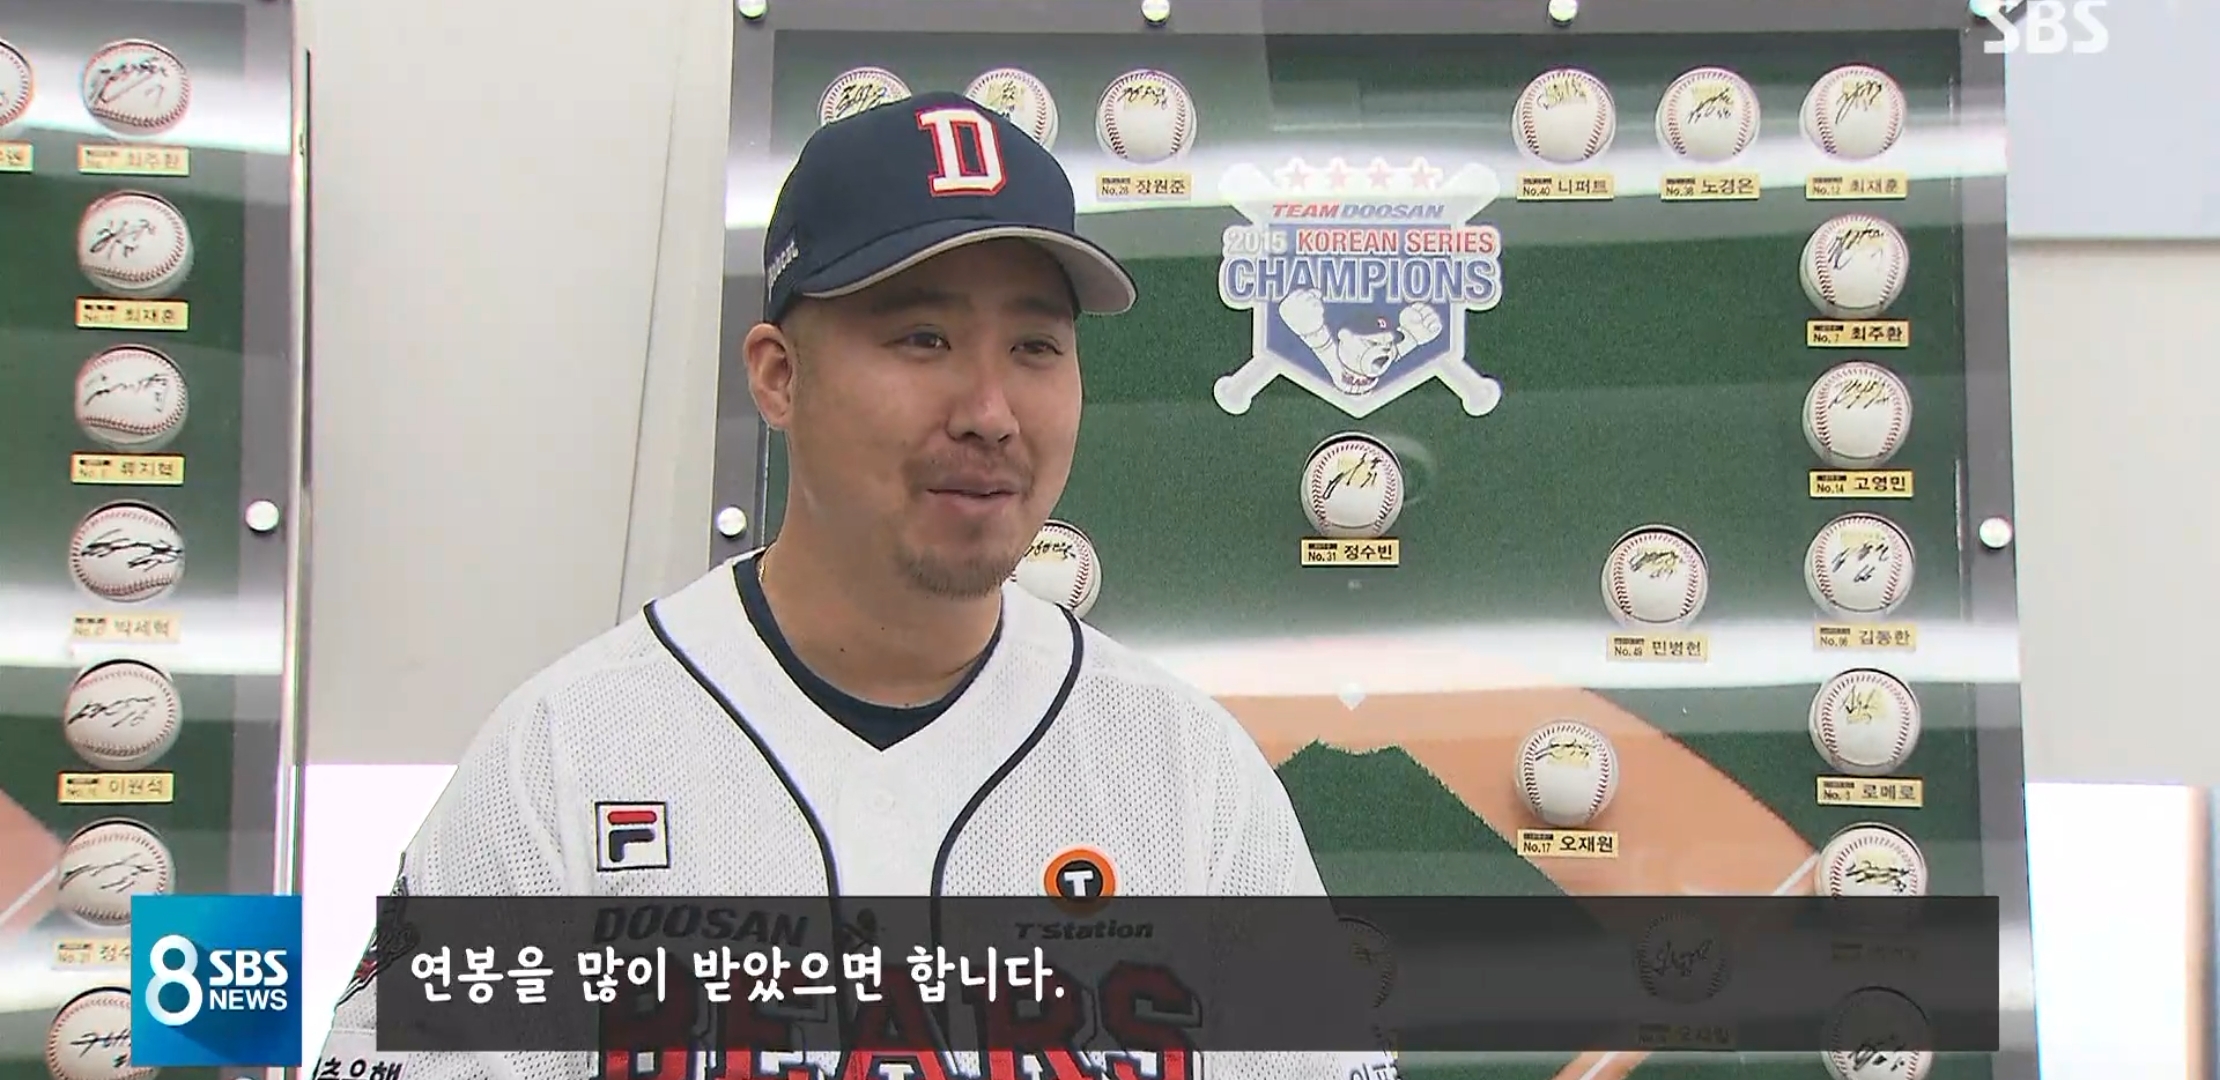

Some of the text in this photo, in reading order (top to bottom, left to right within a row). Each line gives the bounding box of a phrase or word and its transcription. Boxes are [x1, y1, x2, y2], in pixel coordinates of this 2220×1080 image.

[915, 101, 1007, 197] D
[1136, 178, 1185, 195] 장원준
[1558, 178, 1608, 195] 니퍼트
[1701, 177, 1754, 195] 노경은
[1225, 229, 1494, 254] 2015 KOREAN SERIES
[1226, 258, 1496, 301] CHAMPIONS
[1850, 324, 1903, 342] 최주환
[1854, 475, 1906, 492] 고영민
[1344, 544, 1393, 561] 정수빈
[1652, 640, 1701, 657] 민병헌
[1861, 783, 1916, 801] 로메로
[1559, 834, 1614, 853] 오재원
[593, 904, 808, 947] DOOSAN
